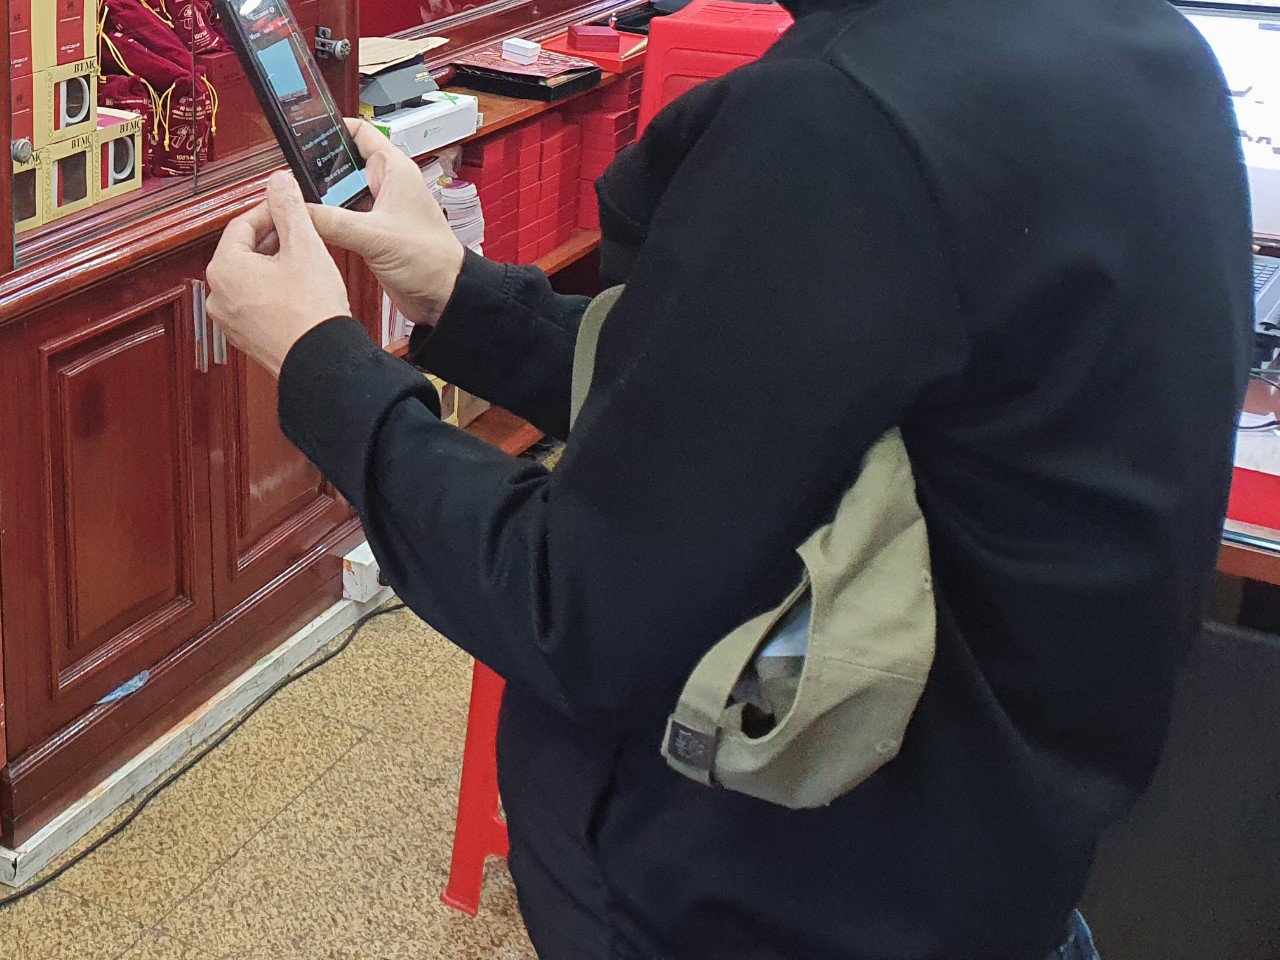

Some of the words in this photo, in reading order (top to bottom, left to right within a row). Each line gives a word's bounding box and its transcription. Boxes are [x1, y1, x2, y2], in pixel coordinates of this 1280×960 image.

[74, 59, 96, 74] BTMC
[119, 119, 141, 134] BTMC
[71, 134, 92, 149] BTMC
